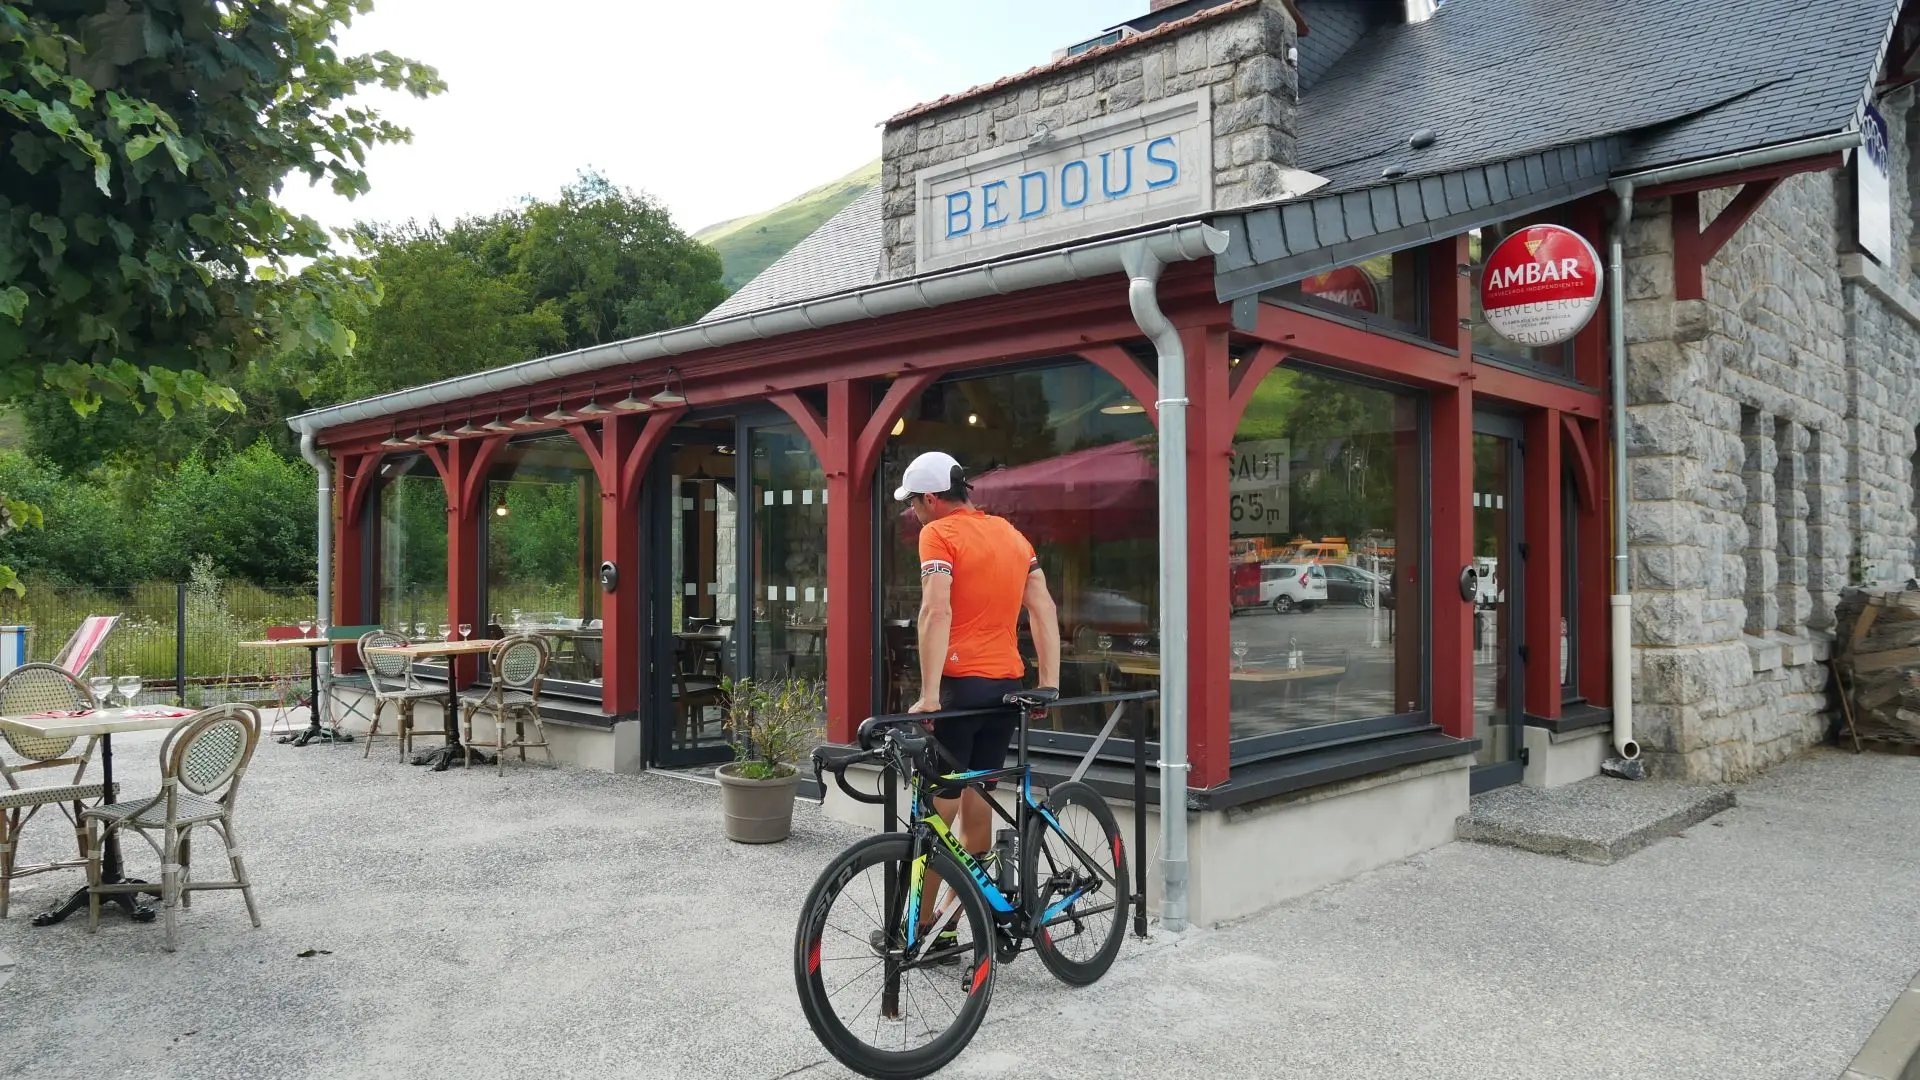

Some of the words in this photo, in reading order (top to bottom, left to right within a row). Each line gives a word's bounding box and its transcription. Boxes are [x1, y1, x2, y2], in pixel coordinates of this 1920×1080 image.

[945, 136, 1179, 240] BEDOUS
[1488, 257, 1583, 290] AMBAR
[944, 829, 996, 889] GIANT
